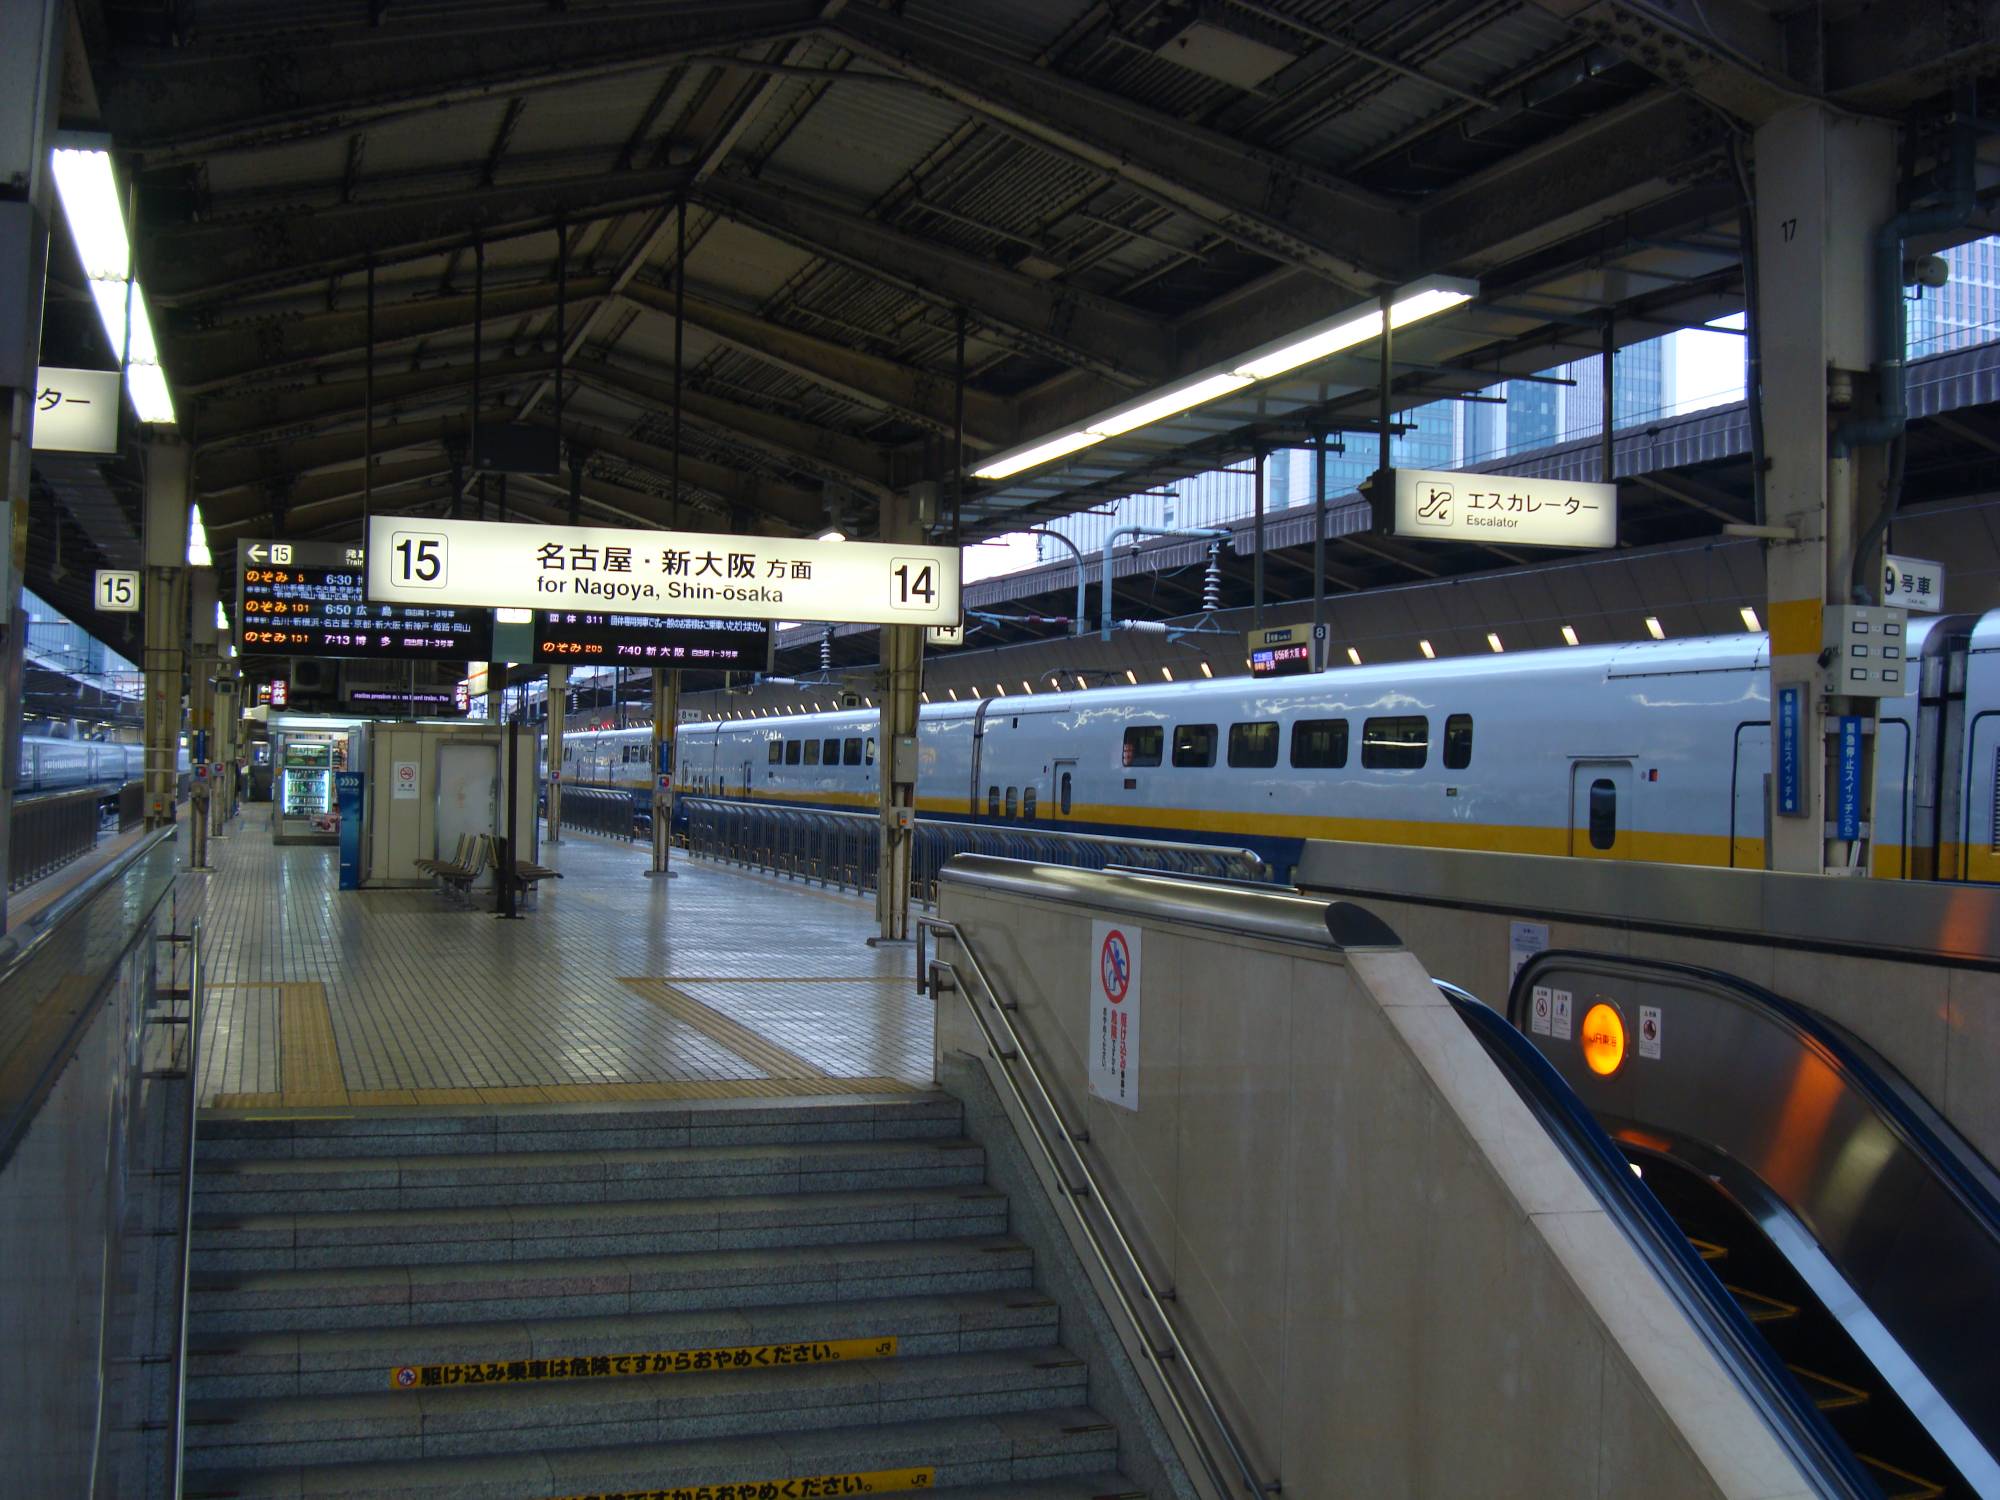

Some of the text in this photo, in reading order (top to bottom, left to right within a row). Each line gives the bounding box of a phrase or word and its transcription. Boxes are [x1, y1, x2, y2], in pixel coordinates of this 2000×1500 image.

[1781, 218, 1796, 243] 17
[1466, 492, 1599, 515] エスカレーター
[1466, 514, 1518, 529] Escalator
[273, 547, 288, 561] 15
[396, 539, 441, 582] 15
[246, 570, 288, 583] のぞみ
[326, 574, 352, 585] 6:30
[894, 564, 936, 604] 14
[103, 577, 131, 603] 15
[537, 576, 567, 594] for
[574, 578, 662, 602] Nagoya,
[245, 600, 287, 613] のぞみ
[292, 604, 309, 613] 101
[325, 604, 351, 615] 6:50
[585, 615, 603, 624] 311
[244, 631, 287, 643] のぞみ
[291, 635, 308, 643] 151
[324, 635, 350, 645] 7:13
[1316, 627, 1323, 638] 8
[543, 642, 582, 653] のぞみ
[585, 644, 603, 653] 205
[617, 645, 642, 656] 7:40
[646, 646, 685, 657] 新大阪
[421, 1343, 891, 1386] 駆け込み乗車は危険ですからおやめください。 JR
